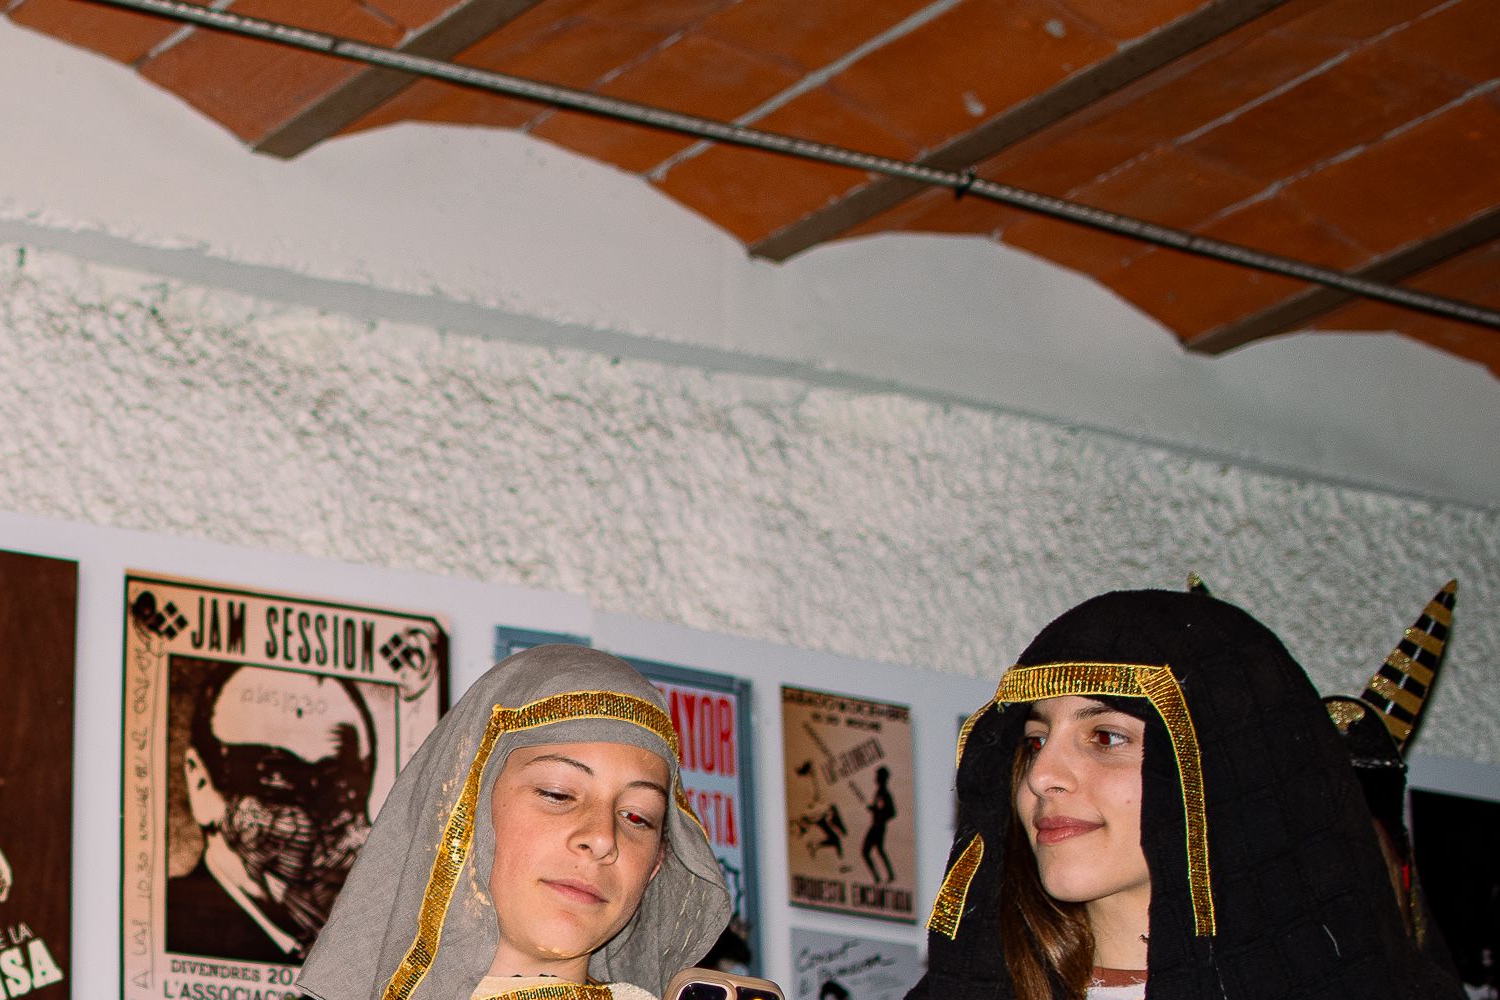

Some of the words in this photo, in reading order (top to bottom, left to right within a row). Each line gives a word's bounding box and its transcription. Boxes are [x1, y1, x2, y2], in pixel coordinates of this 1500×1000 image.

[191, 596, 246, 655] JAM
[265, 606, 375, 674] SESSION
[7, 922, 34, 945] LA
[171, 959, 261, 983] DIVENDRES
